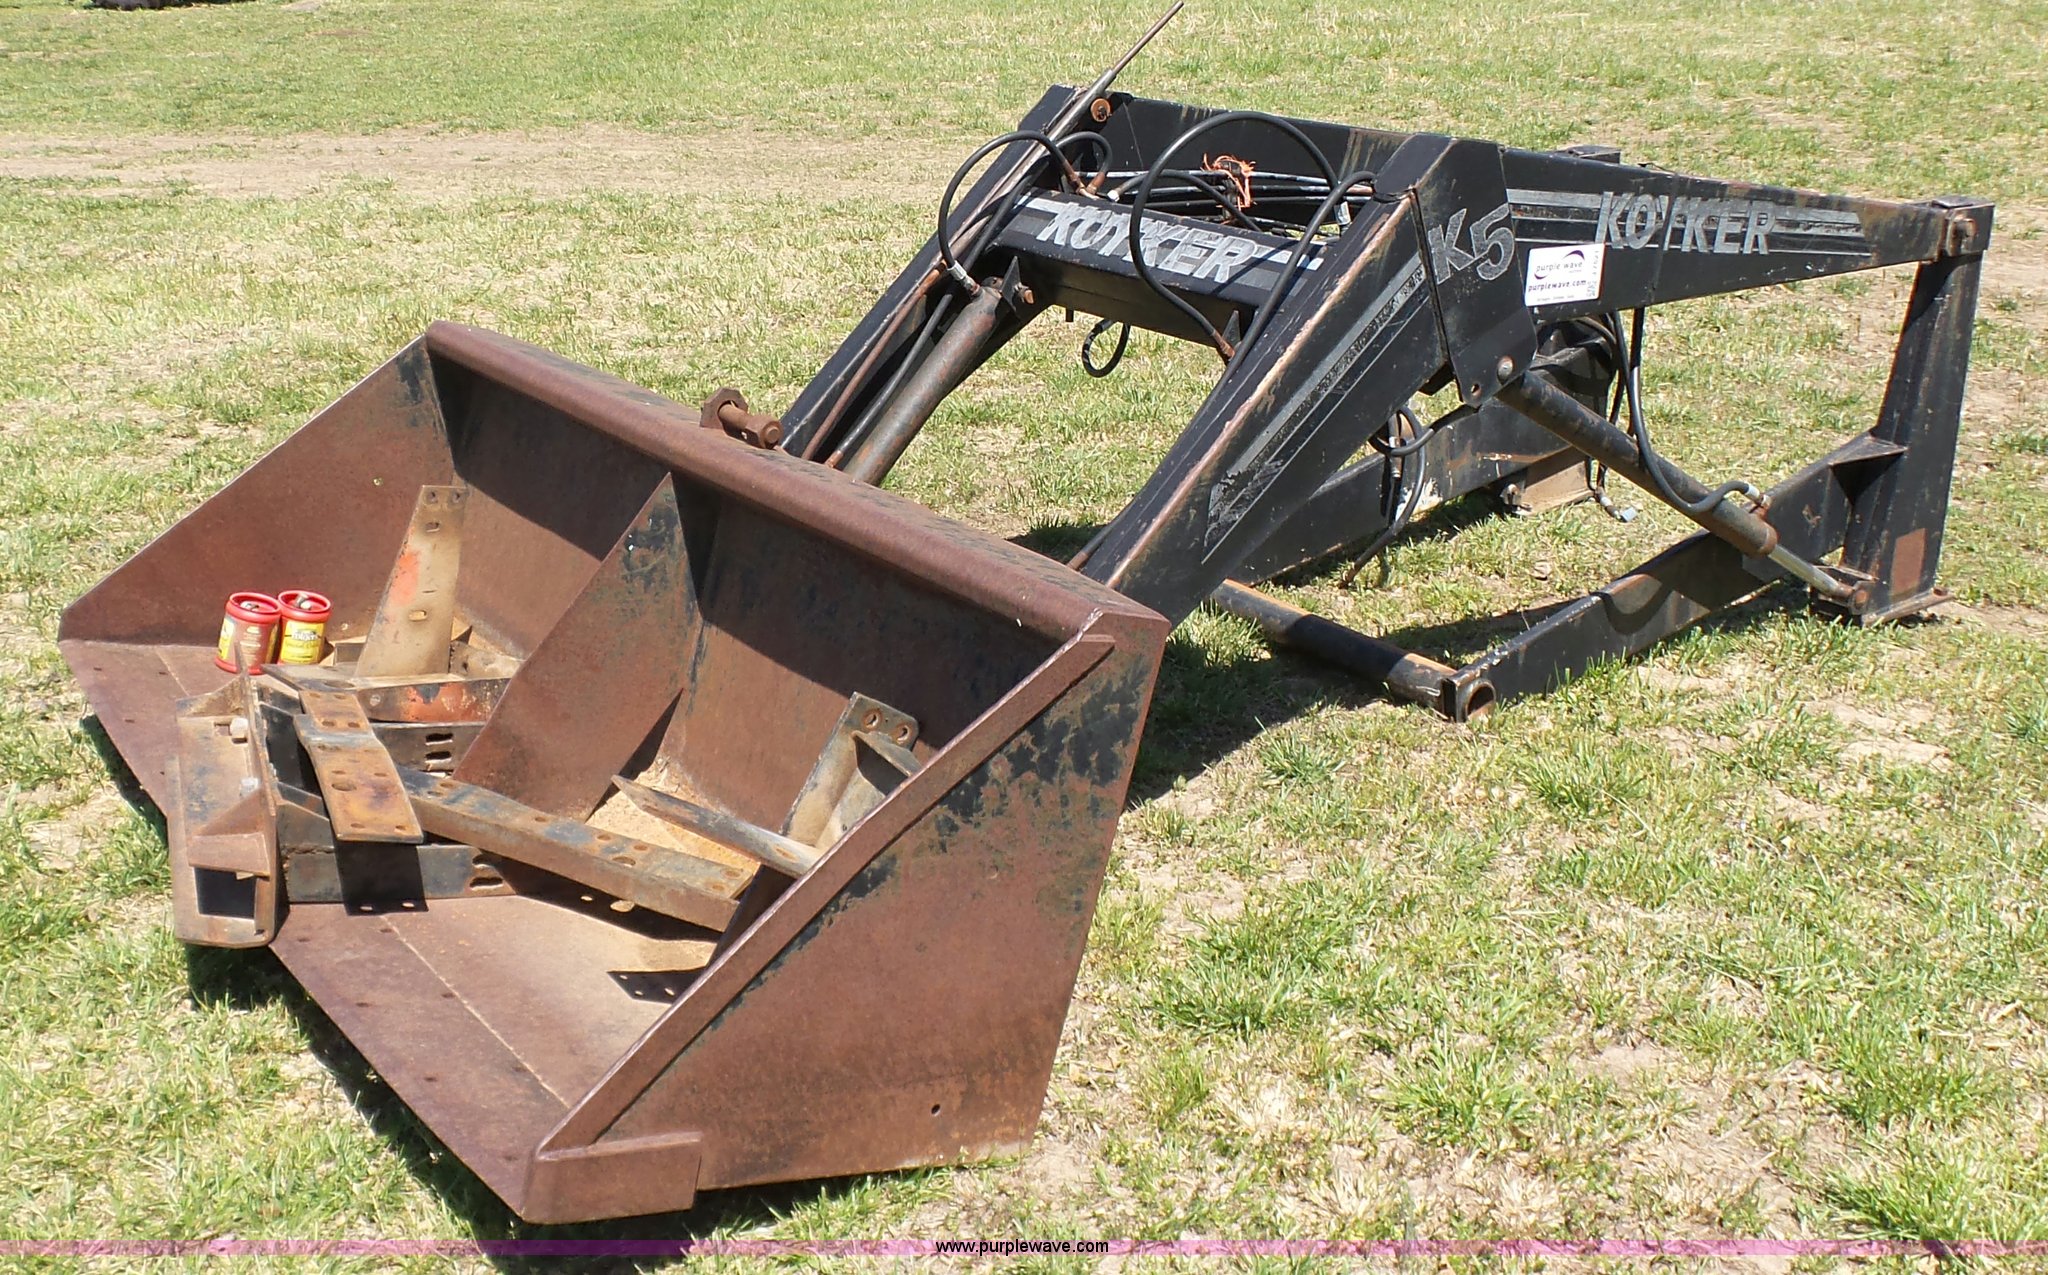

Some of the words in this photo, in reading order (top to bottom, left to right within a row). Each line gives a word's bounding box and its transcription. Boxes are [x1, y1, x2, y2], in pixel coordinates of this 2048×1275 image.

[1037, 202, 1257, 283] KOYKER
[1427, 203, 1515, 284] K5
[1596, 191, 1774, 254] KOYKER
[1528, 280, 1587, 292] purplewave.com
[1536, 264, 1561, 272] purple
